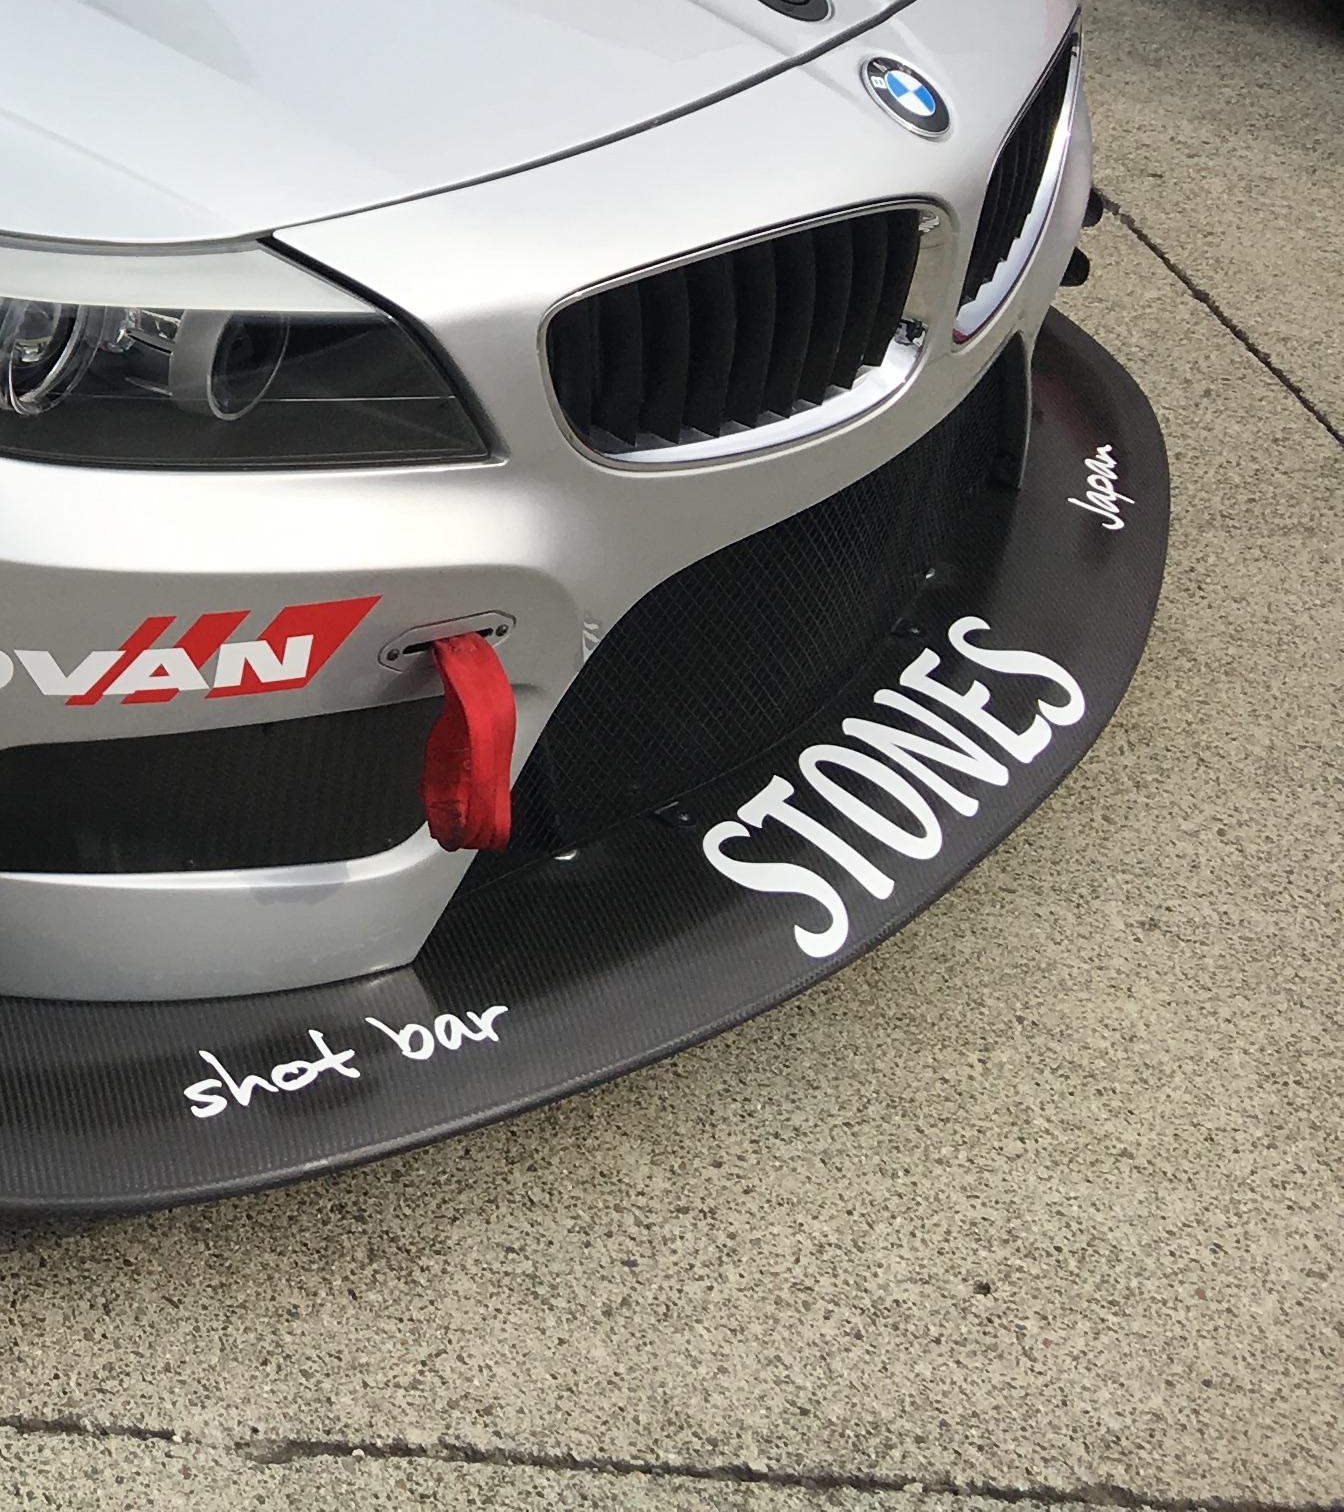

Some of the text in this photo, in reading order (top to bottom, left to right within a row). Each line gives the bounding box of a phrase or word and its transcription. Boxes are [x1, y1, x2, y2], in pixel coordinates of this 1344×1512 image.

[1067, 443, 1114, 531] Japan
[702, 615, 1086, 959] STONES
[183, 1005, 509, 1119] shot bar
